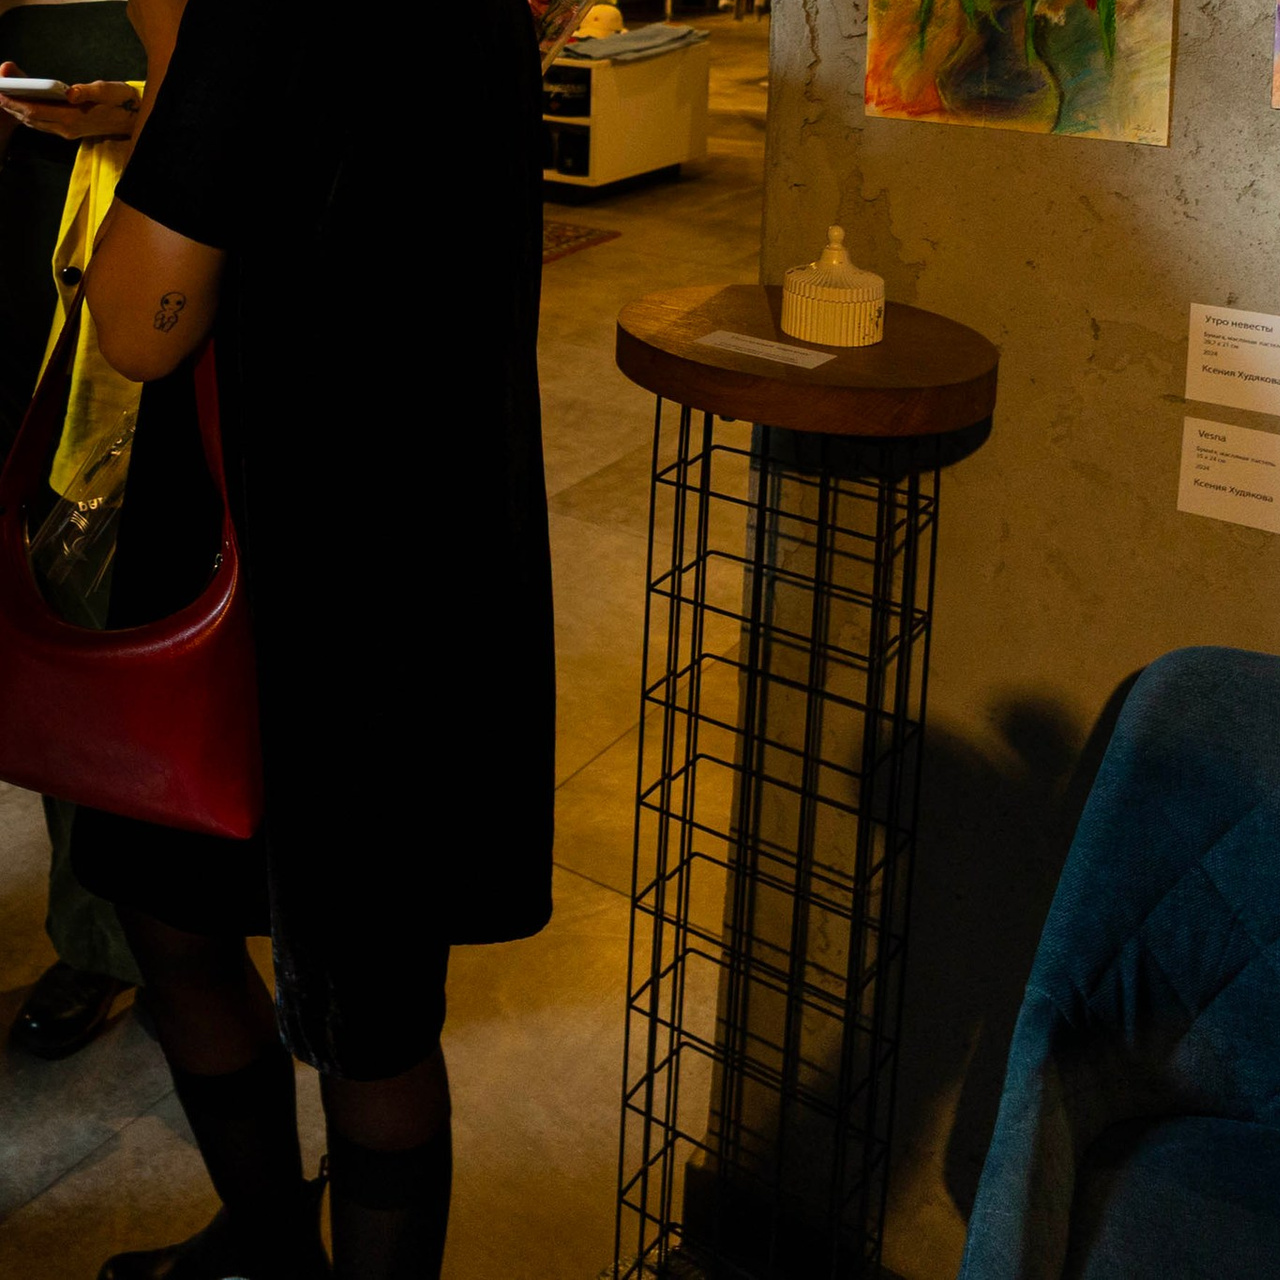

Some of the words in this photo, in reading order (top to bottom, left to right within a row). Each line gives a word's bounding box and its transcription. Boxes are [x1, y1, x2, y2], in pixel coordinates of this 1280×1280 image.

[1205, 315, 1229, 327] Утро
[1231, 321, 1274, 333] невесты
[1202, 364, 1235, 377] Ксения
[1198, 429, 1226, 442] Vesna
[1193, 478, 1227, 491] Ксения
[1228, 485, 1273, 502] Худякова
